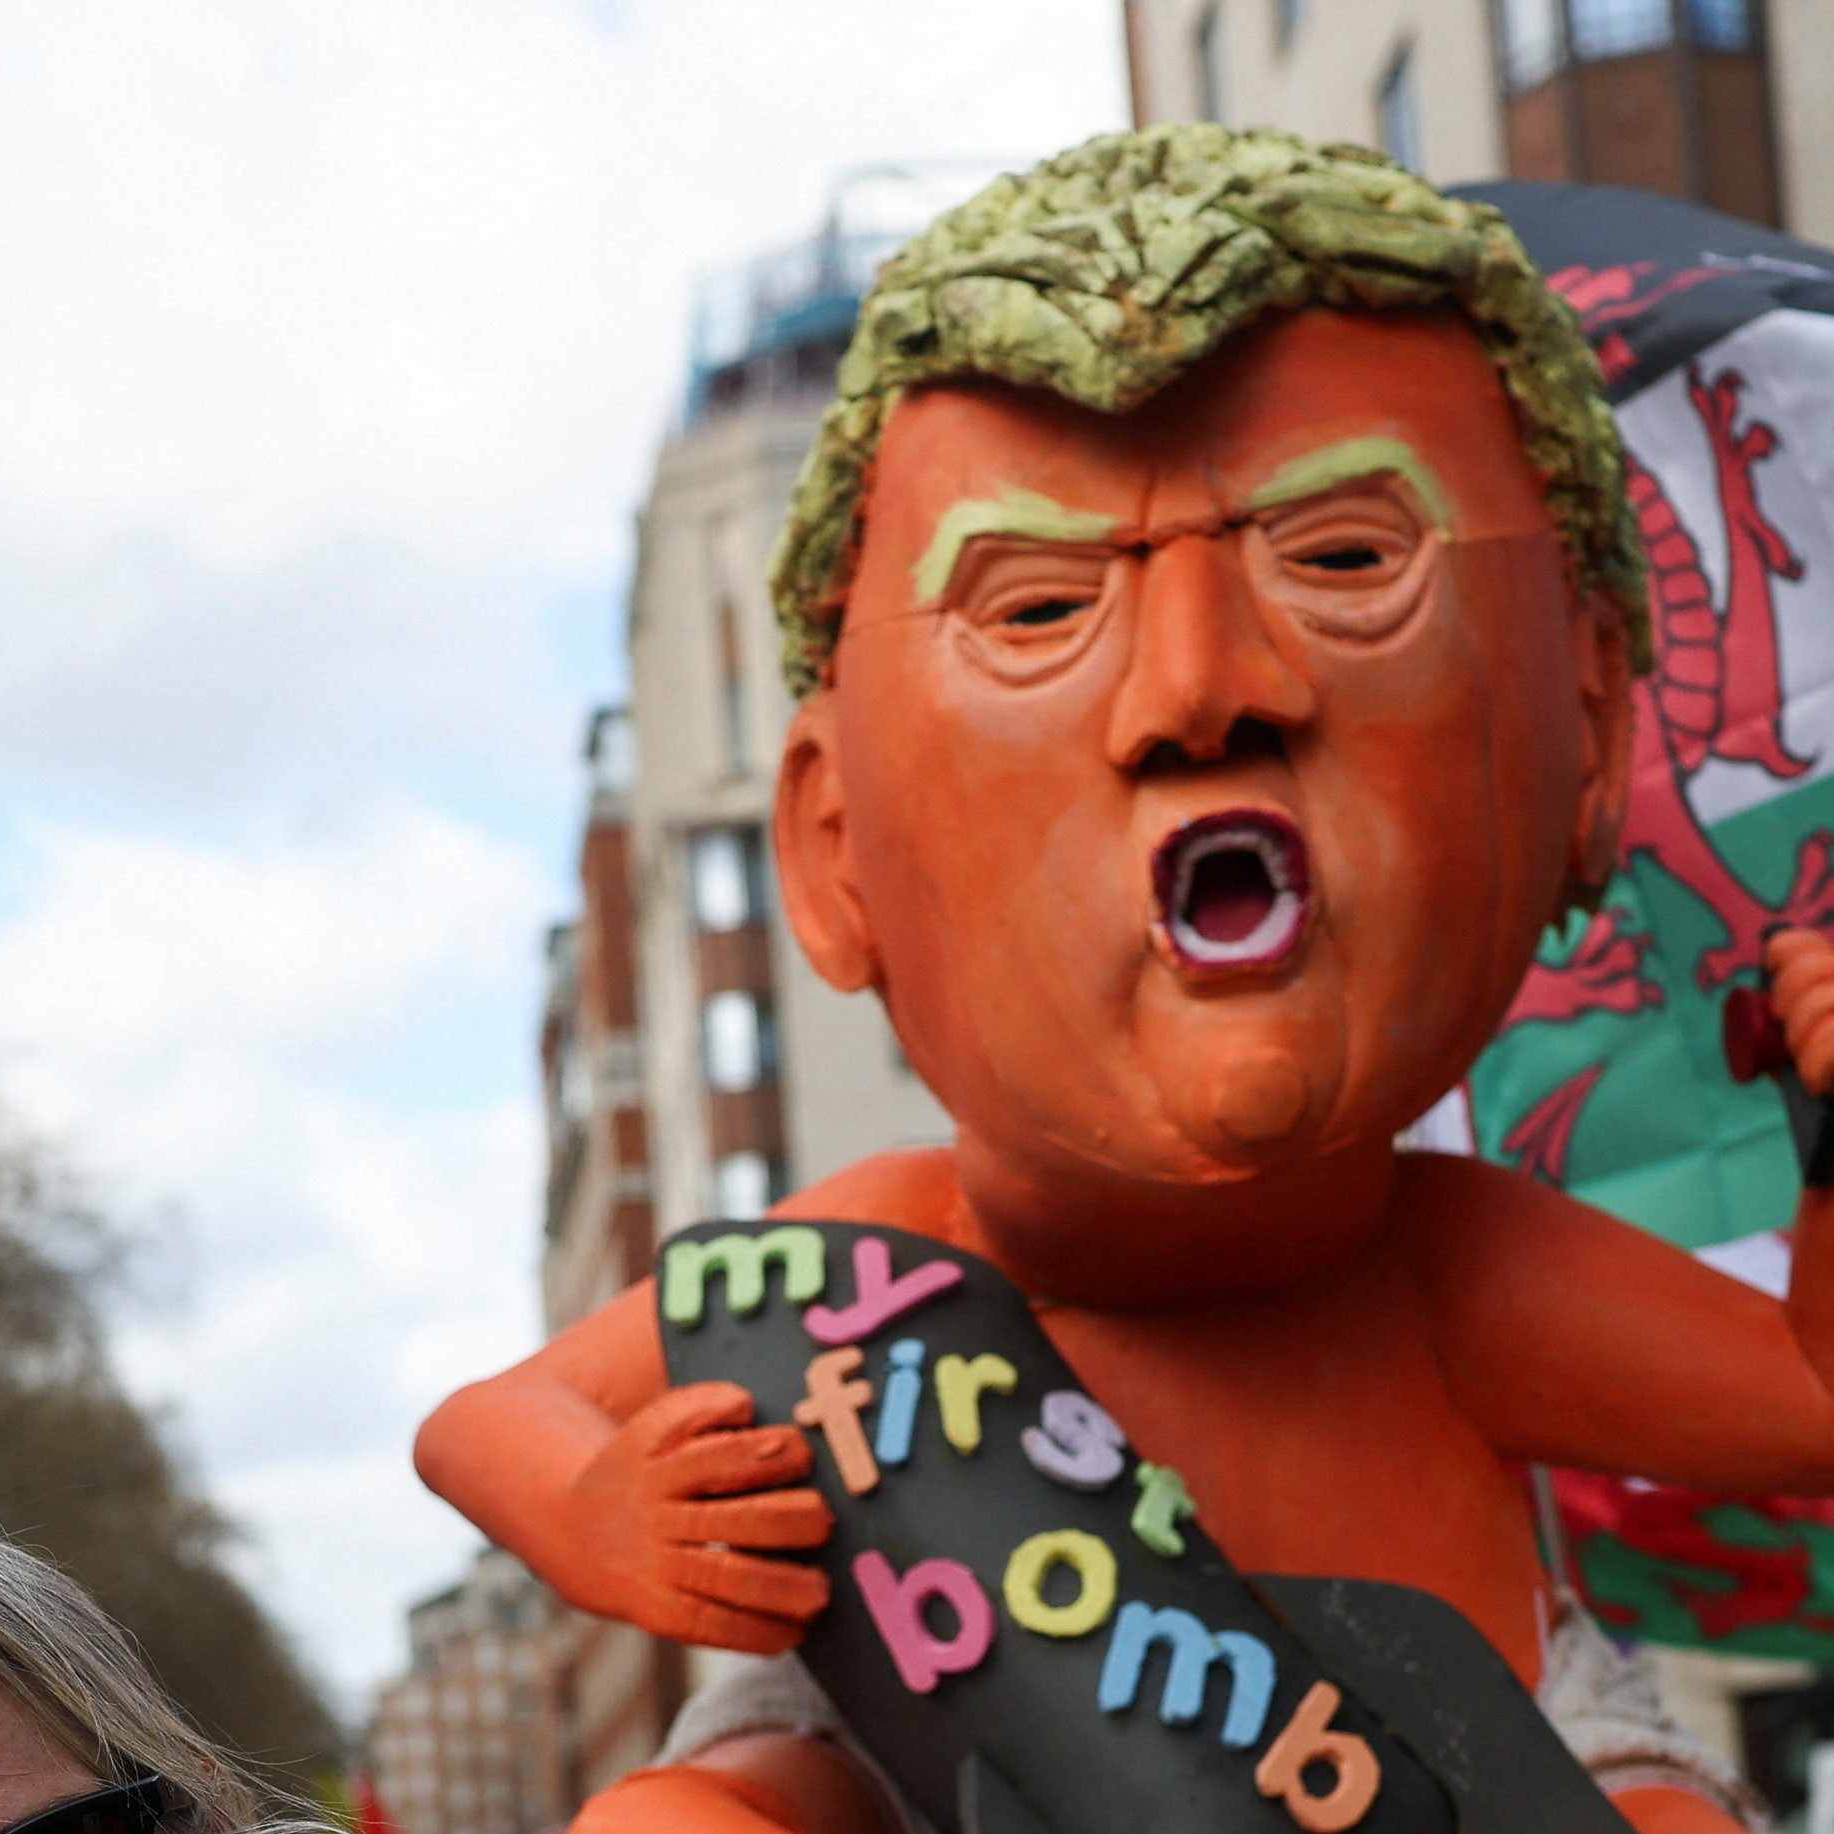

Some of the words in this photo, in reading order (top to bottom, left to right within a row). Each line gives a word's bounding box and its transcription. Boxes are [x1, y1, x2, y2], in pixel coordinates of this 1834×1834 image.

[662, 1226, 963, 1347] my
[794, 1338, 1197, 1557] first
[853, 1528, 1381, 1834] bomb
